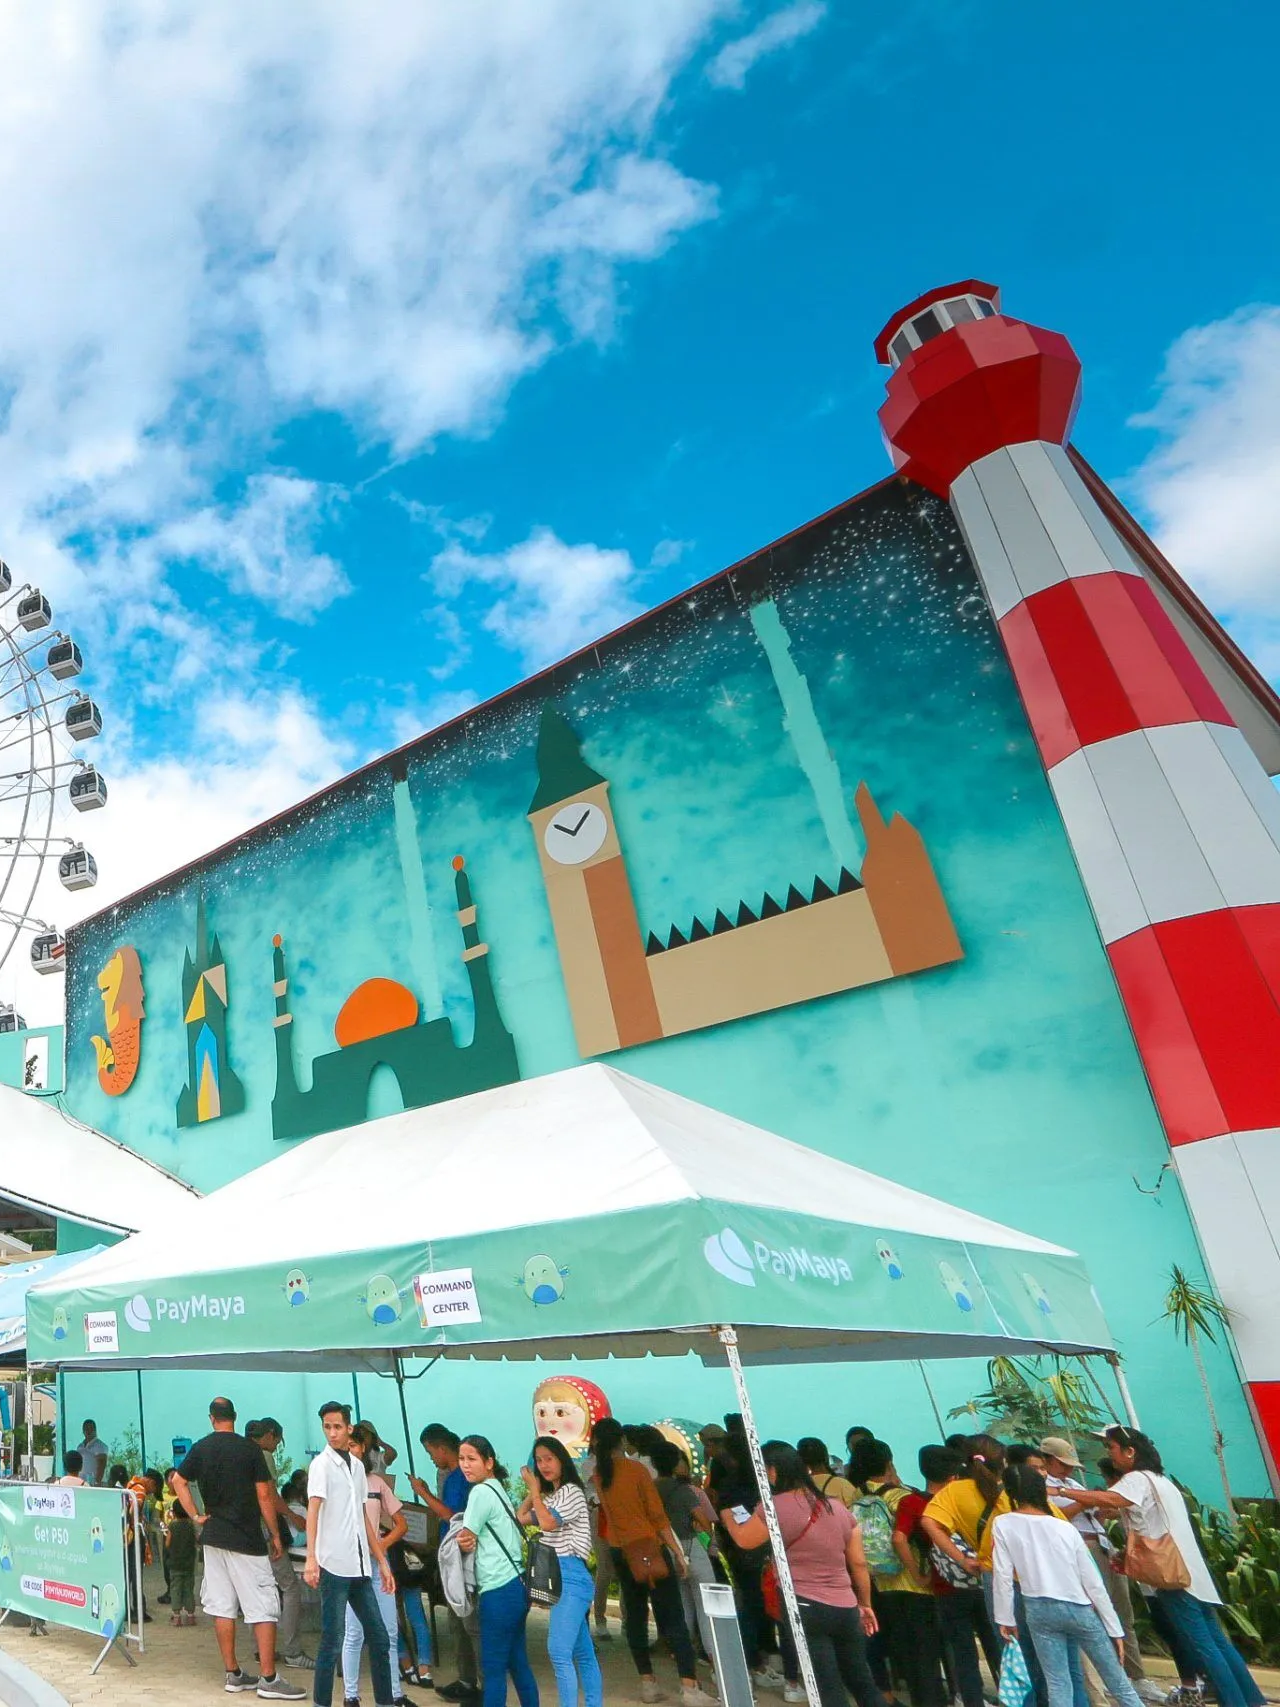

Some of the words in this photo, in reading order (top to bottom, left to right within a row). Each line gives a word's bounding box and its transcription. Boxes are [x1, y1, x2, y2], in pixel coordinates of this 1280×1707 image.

[753, 1240, 853, 1286] PayMaya
[422, 1280, 473, 1295] COMMAND
[155, 1294, 246, 1324] PayMaya
[432, 1301, 470, 1314] CENTER
[89, 1319, 116, 1328] COMMAND
[93, 1335, 113, 1343] CENTER
[33, 1497, 55, 1510] PayMaya
[34, 1525, 49, 1541] Get
[52, 1526, 69, 1545] P50
[23, 1580, 31, 1590] USE
[31, 1581, 43, 1592] CODE
